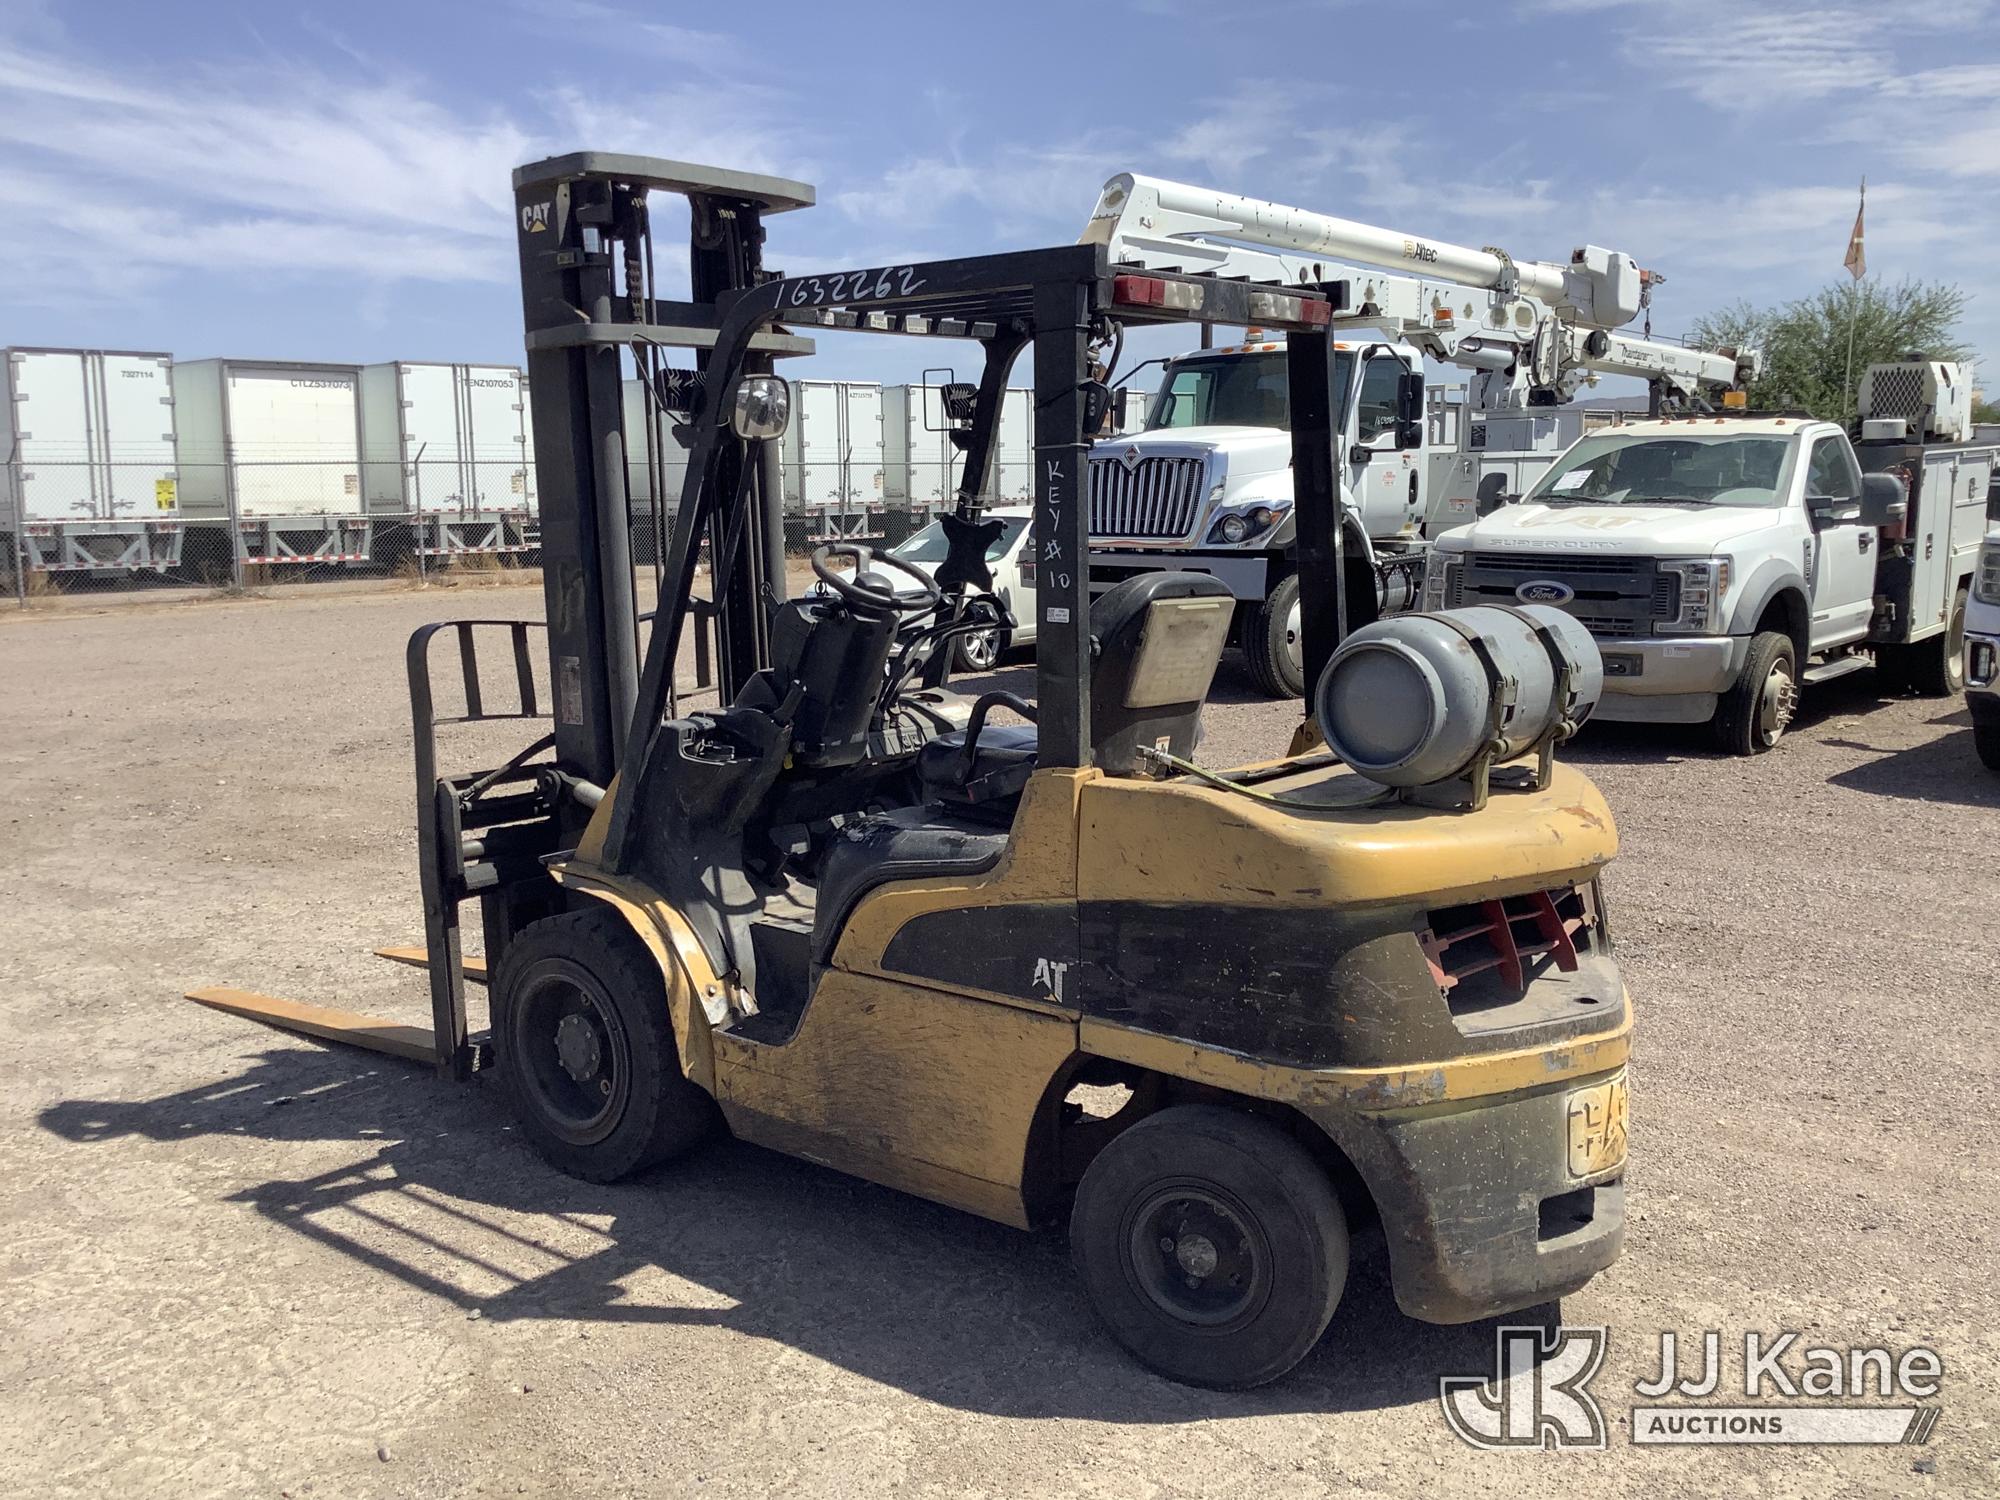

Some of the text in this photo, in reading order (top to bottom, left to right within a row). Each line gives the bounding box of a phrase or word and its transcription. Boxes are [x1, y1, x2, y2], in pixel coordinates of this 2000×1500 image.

[522, 202, 551, 232] CAT
[1413, 242, 1438, 263] Altec
[774, 267, 927, 309] 1632262
[1488, 538, 1623, 549] SUPER DUTY
[1050, 571, 1070, 588] 10
[1529, 586, 1559, 600] Ford
